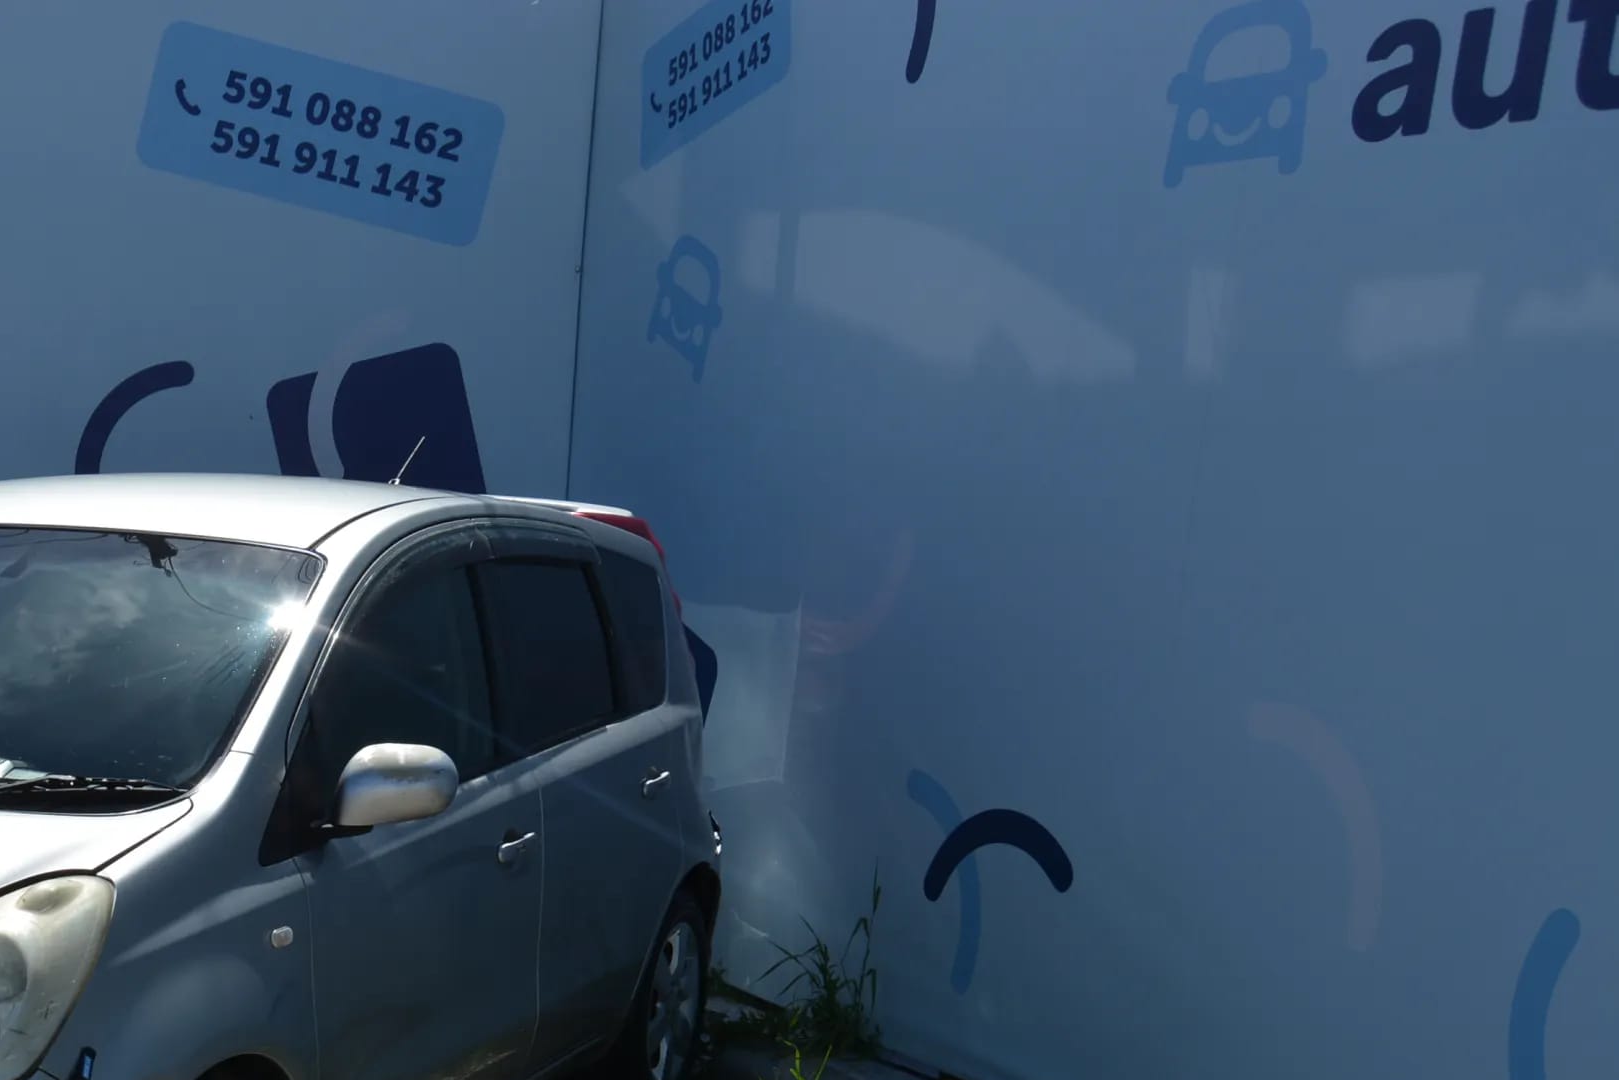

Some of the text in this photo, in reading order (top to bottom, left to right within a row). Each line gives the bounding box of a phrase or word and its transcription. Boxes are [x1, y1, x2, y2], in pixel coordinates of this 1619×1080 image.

[668, 42, 698, 87] 591
[702, 14, 735, 61] 088
[668, 31, 771, 129] 591 911 143
[222, 70, 463, 162] 591 088 162
[210, 119, 446, 209] 591 911 143
